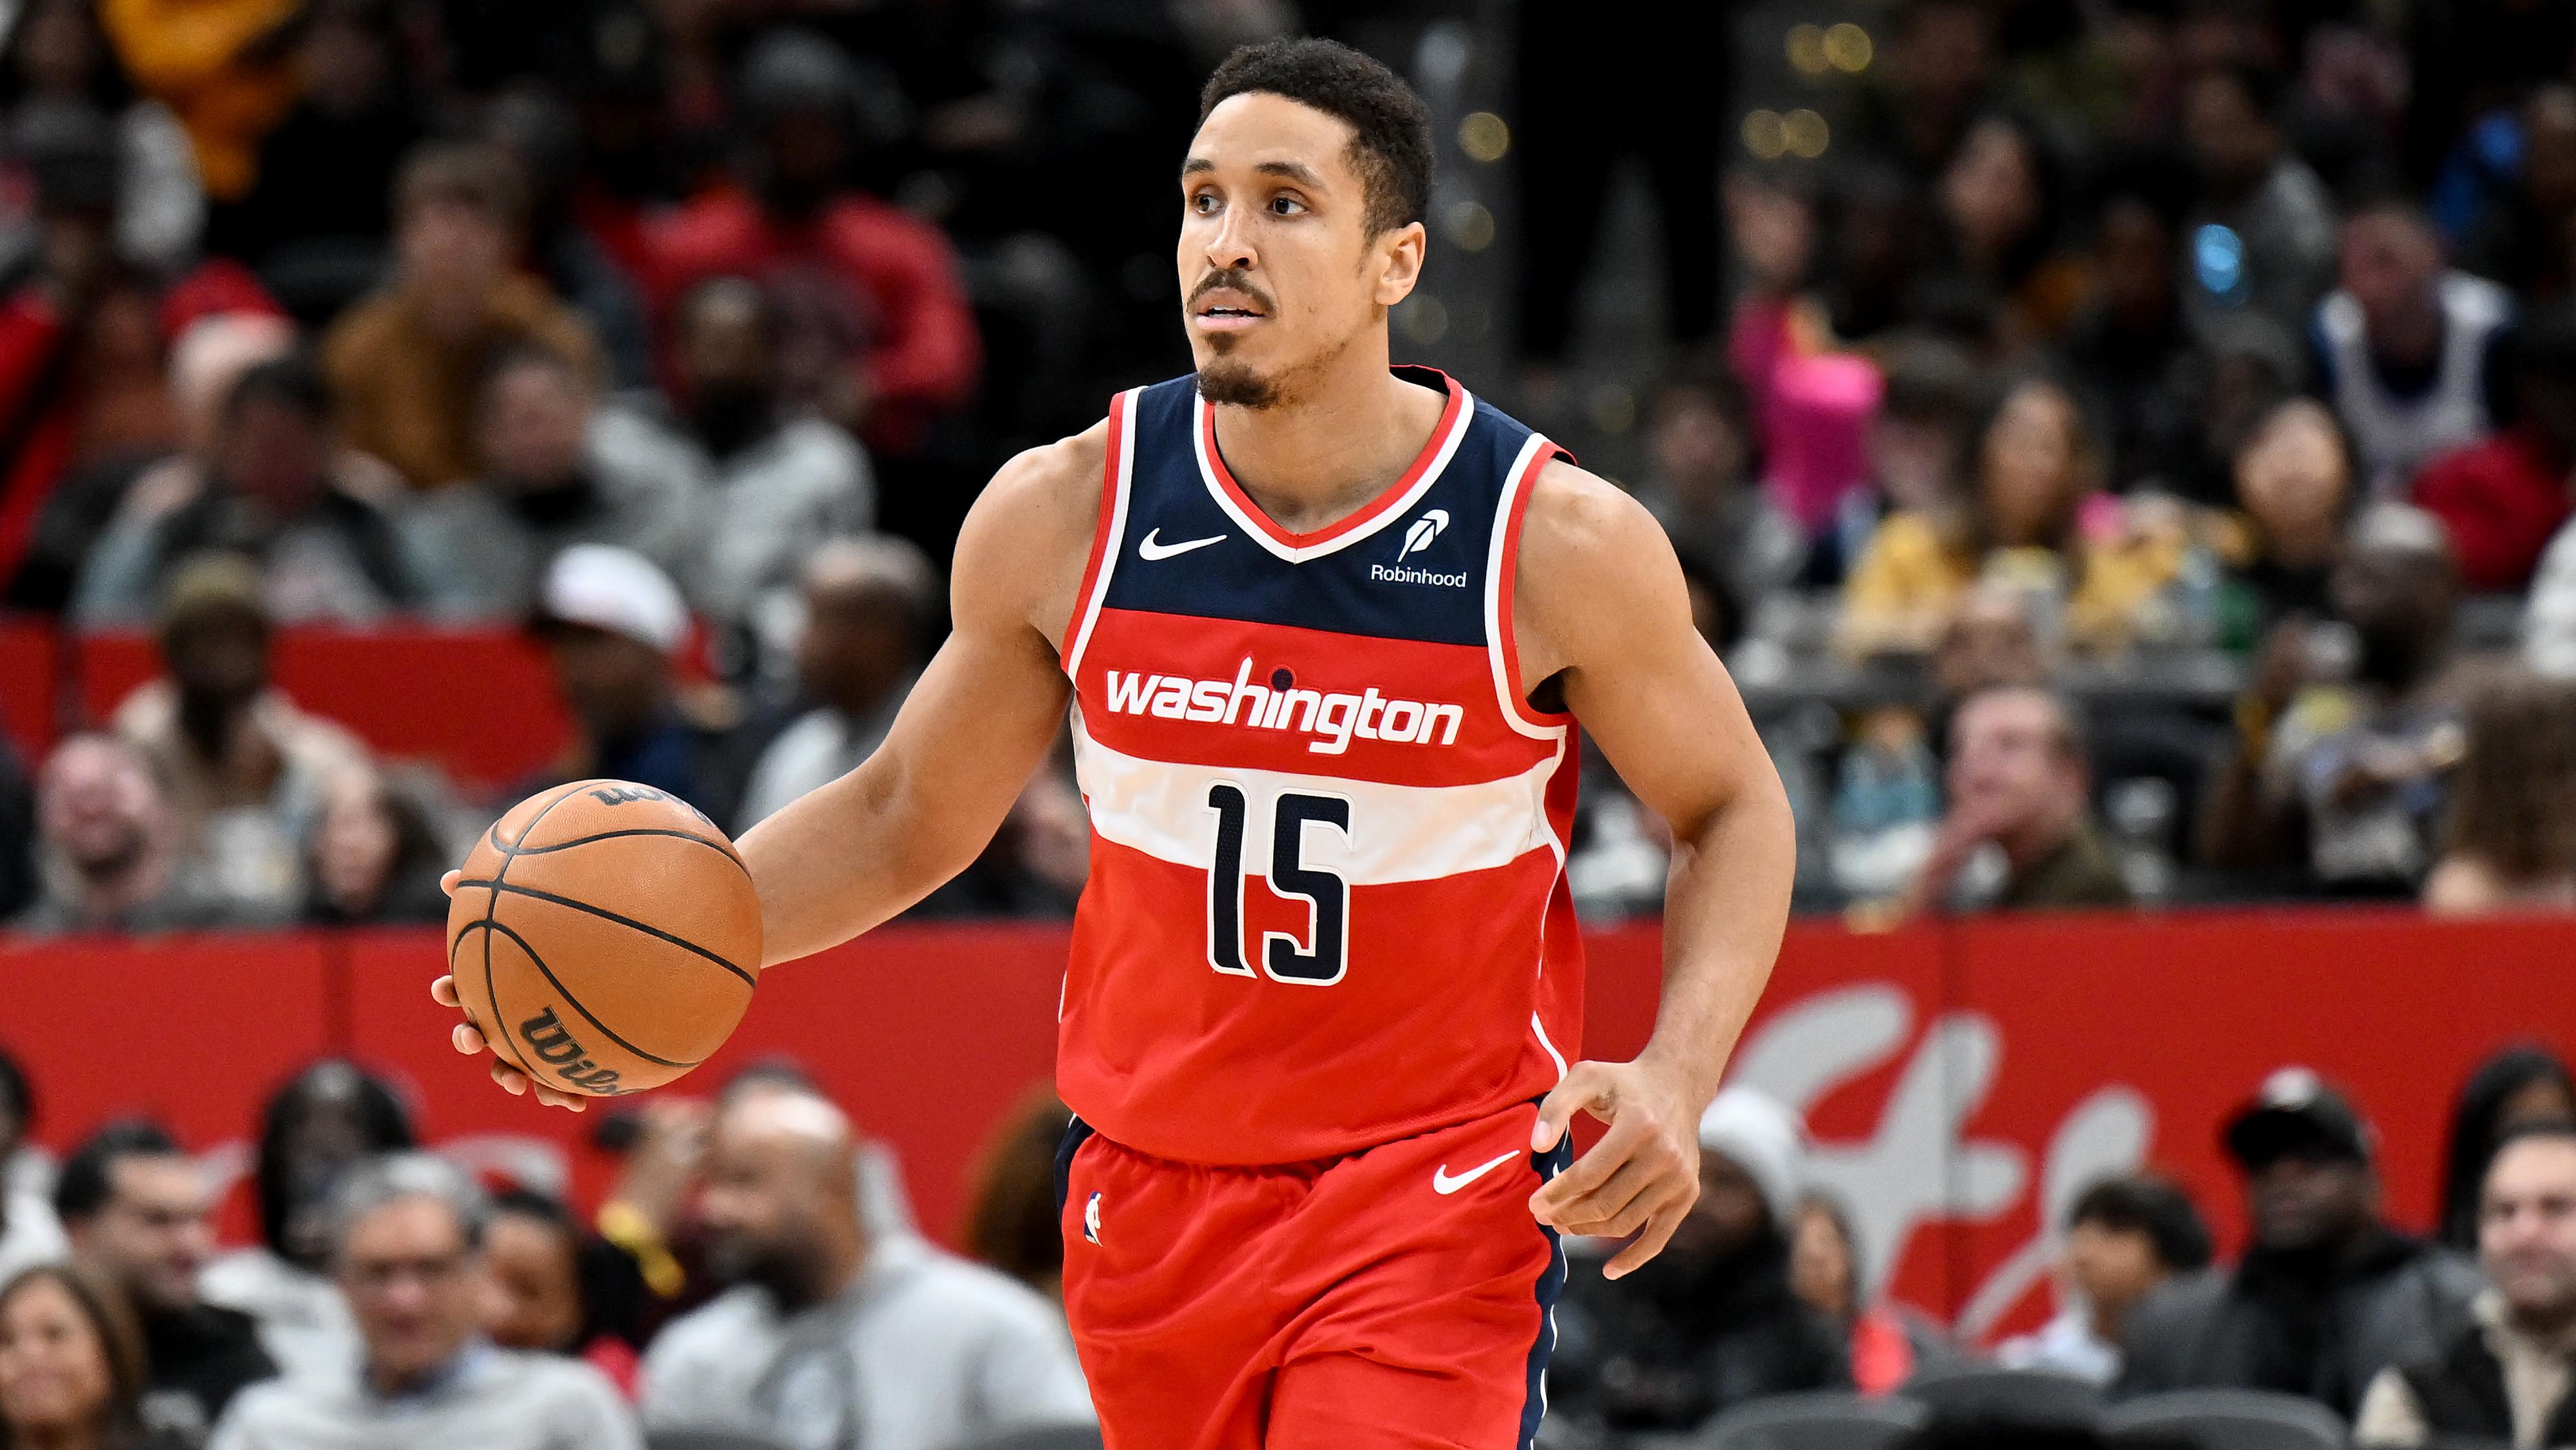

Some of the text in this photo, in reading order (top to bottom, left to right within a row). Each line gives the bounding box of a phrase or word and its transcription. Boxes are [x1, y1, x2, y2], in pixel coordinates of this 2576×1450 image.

[1371, 564, 1467, 587] Robinhood
[1107, 654, 1464, 755] washington
[1203, 778, 1354, 987] 15
